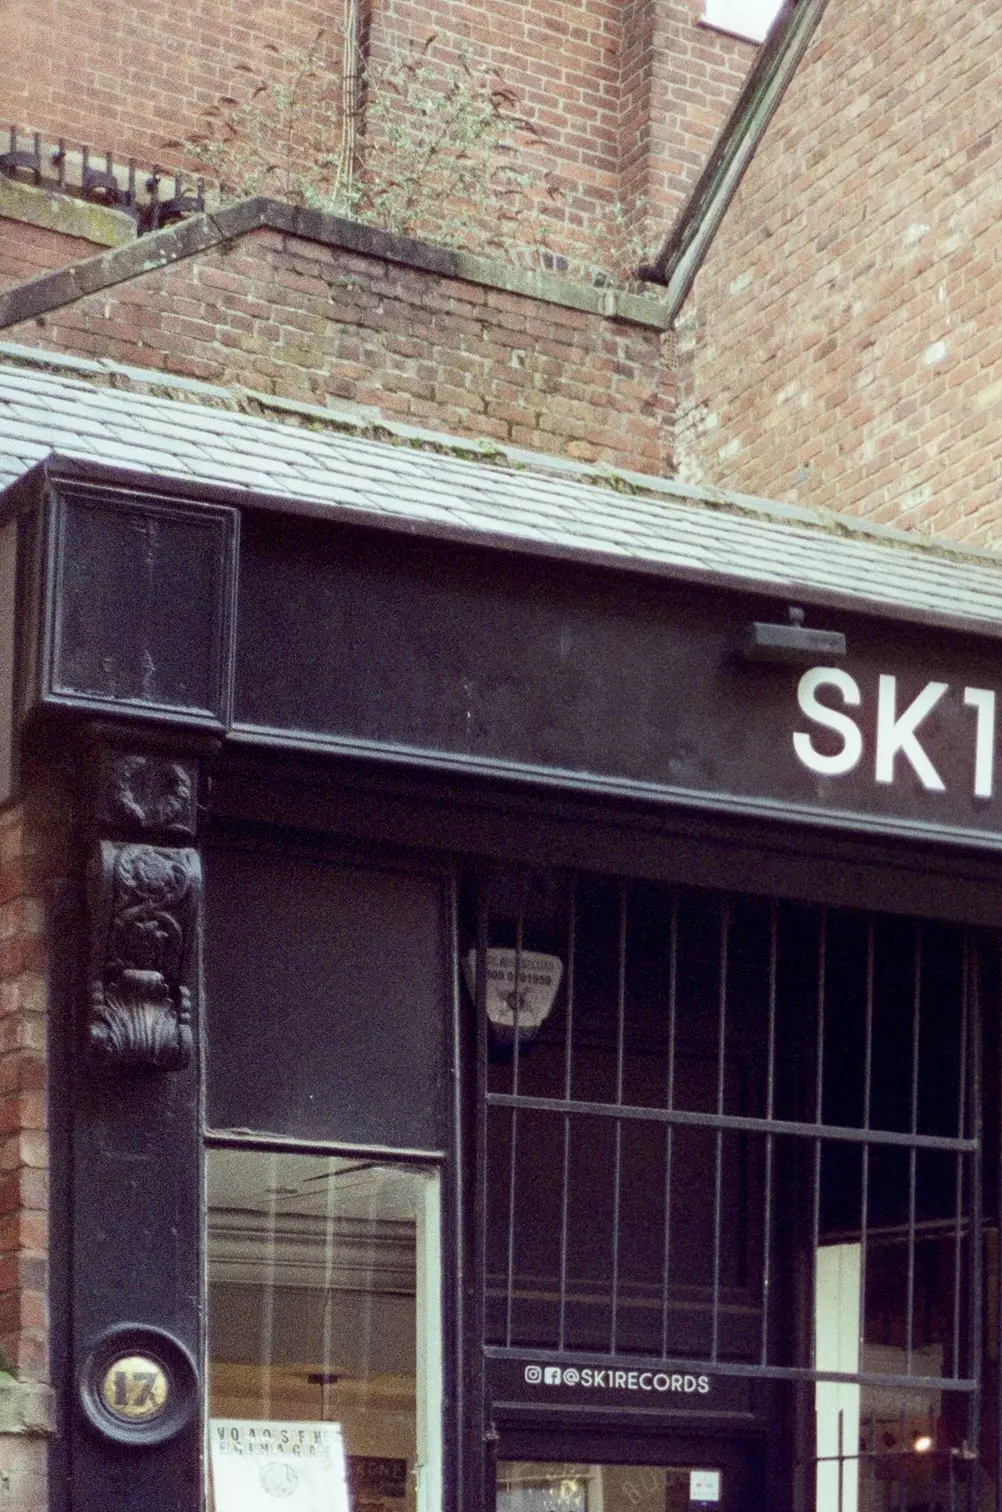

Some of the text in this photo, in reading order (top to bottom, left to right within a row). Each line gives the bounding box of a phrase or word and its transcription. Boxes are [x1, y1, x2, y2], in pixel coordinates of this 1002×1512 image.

[792, 666, 996, 798] SK1
[114, 1371, 158, 1407] 17
[563, 1368, 710, 1394] @SK1RECORDS
